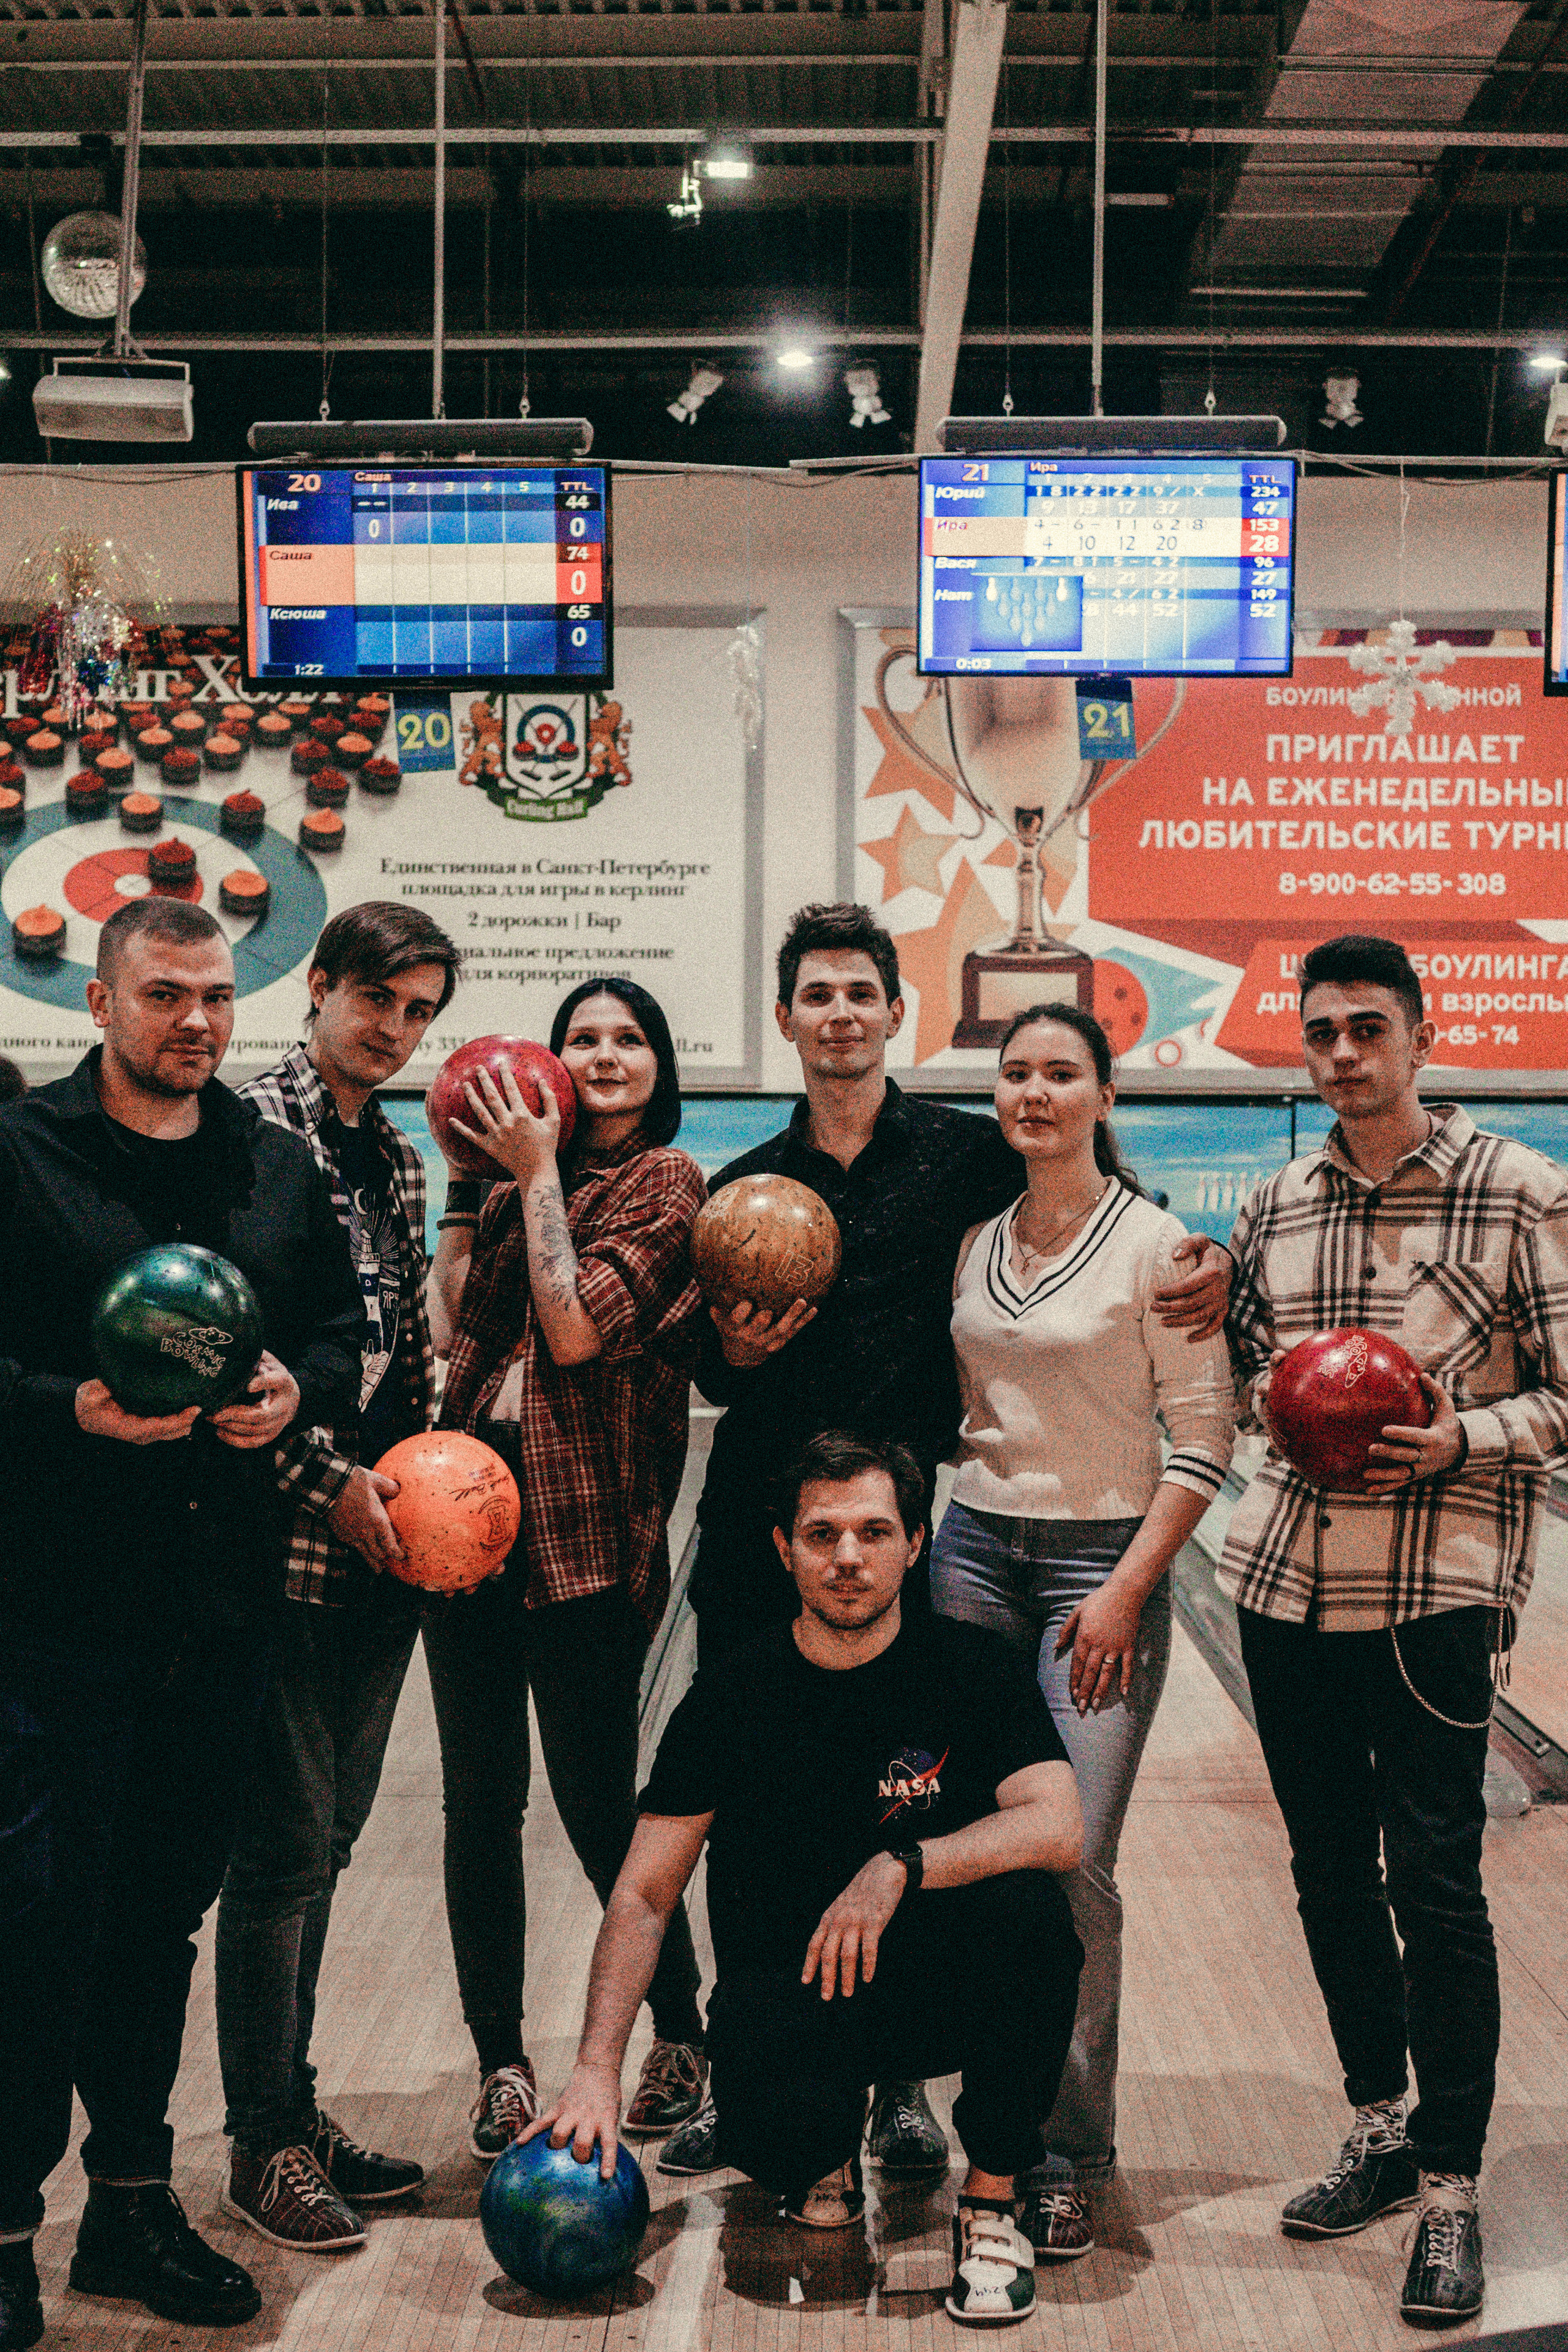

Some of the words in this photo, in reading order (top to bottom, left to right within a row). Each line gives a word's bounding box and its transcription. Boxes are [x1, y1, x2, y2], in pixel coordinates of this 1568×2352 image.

[962, 463, 990, 481] 21
[1030, 462, 1058, 473] Ира
[287, 473, 321, 492] 20
[354, 472, 392, 482] Саша
[1248, 475, 1281, 484] TTL
[407, 482, 418, 494] 2
[443, 481, 455, 492] 3
[480, 481, 492, 492] 4
[519, 481, 530, 492] 5
[560, 481, 594, 491] TTL
[935, 486, 986, 501] Юрий
[1251, 486, 1281, 497] 234
[565, 495, 590, 509] 44
[1252, 500, 1279, 515] 47
[368, 518, 380, 538] 0
[569, 516, 586, 538] 0
[937, 520, 968, 531] Ира
[1170, 519, 1180, 530] 2
[1250, 519, 1279, 532] 153
[1079, 535, 1096, 551] 10
[1119, 535, 1135, 551] 12
[1156, 535, 1177, 551] 20
[1249, 535, 1280, 552] 28
[269, 550, 312, 560] Саша
[567, 546, 589, 561] 74
[935, 556, 977, 569] Вася
[1254, 556, 1275, 568] 96
[570, 570, 587, 596] 0
[1251, 571, 1277, 586] 27
[1251, 589, 1277, 600] 149
[269, 608, 327, 620] Ксюша
[567, 604, 591, 620] 65
[1250, 603, 1276, 618] 52
[571, 626, 587, 647] 0
[295, 663, 325, 676] 1:22
[956, 658, 992, 670] 0:03
[1083, 702, 1129, 738] 21
[398, 712, 451, 750] 20
[1265, 734, 1526, 763] ПРИГЛАШАЕТ
[1202, 777, 1255, 806] НА
[1267, 777, 1568, 813] ЕЖЕНЕДЕЛЬНЫ
[1138, 820, 1452, 850] ЛЮБИТЕЛЬСКИЕ
[1462, 820, 1568, 851] ТУРН
[380, 858, 517, 876] Единственная
[522, 864, 532, 874] в
[535, 858, 711, 880] Санкт-Петербурге
[402, 884, 497, 898] площадка
[500, 884, 535, 898] для
[540, 885, 590, 902] игры
[594, 886, 606, 896] в
[609, 885, 690, 902] керлинг
[468, 911, 479, 927] 2
[481, 916, 569, 933] дорожки
[587, 911, 622, 933] Бар
[545, 948, 674, 964] предложение
[774, 1250, 814, 1287] 13
[160, 1338, 221, 1378] BOWLING
[173, 1332, 227, 1369] COSMIC
[878, 1777, 941, 1797] NASA
